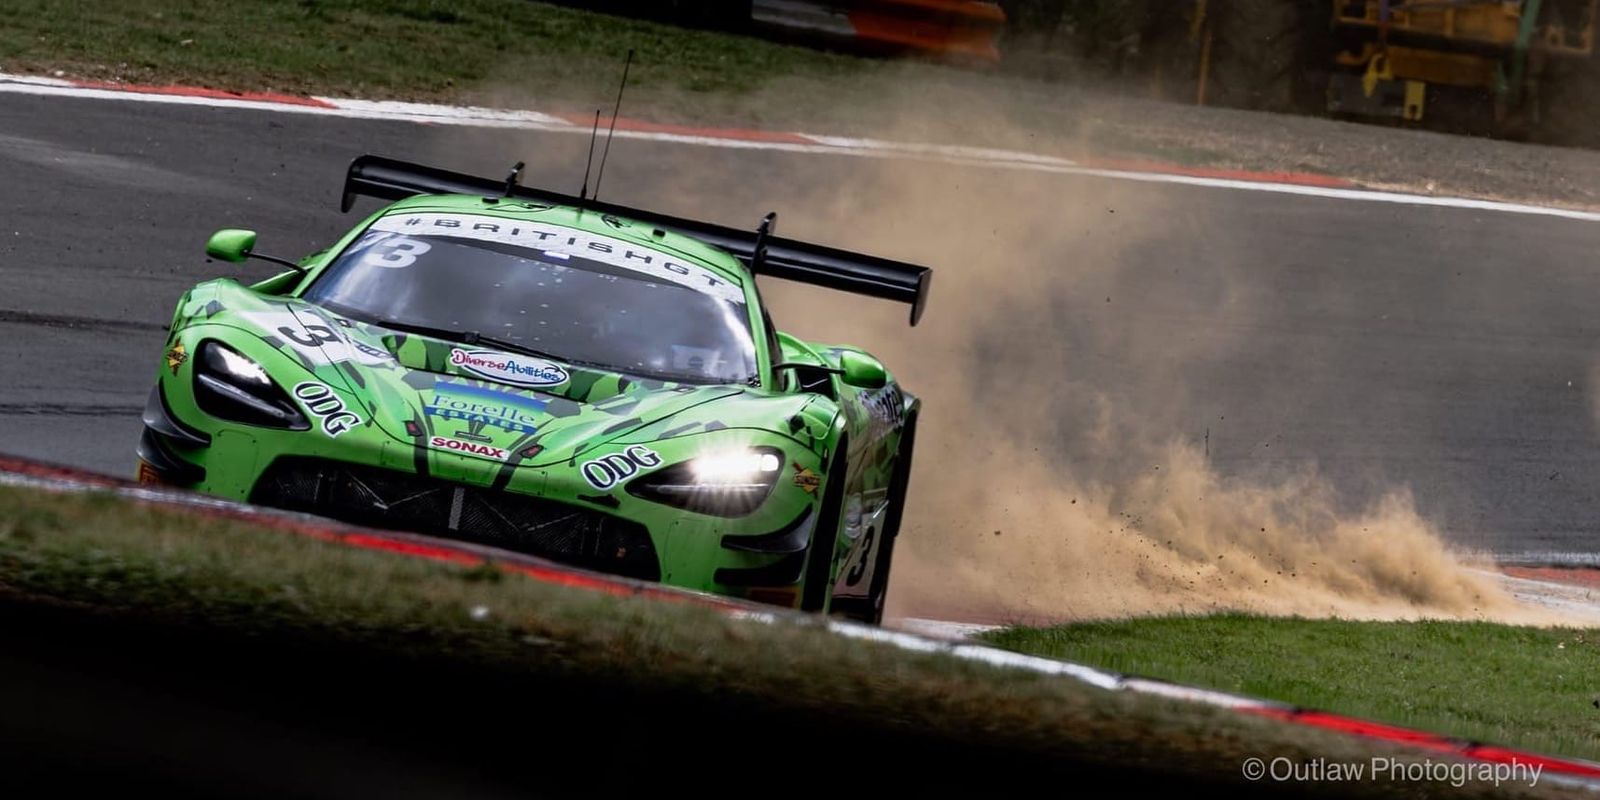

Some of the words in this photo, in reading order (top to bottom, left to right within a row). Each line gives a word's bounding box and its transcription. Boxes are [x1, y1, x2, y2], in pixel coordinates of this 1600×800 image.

[363, 236, 432, 268] 3
[405, 217, 725, 286] #BRITISHGT
[278, 325, 343, 347] 3
[294, 382, 360, 435] ODG
[433, 394, 536, 423] Forelle
[435, 408, 524, 430] ESTATES
[432, 437, 504, 458] SONAX
[583, 445, 663, 489] ODG
[846, 525, 874, 587] 3
